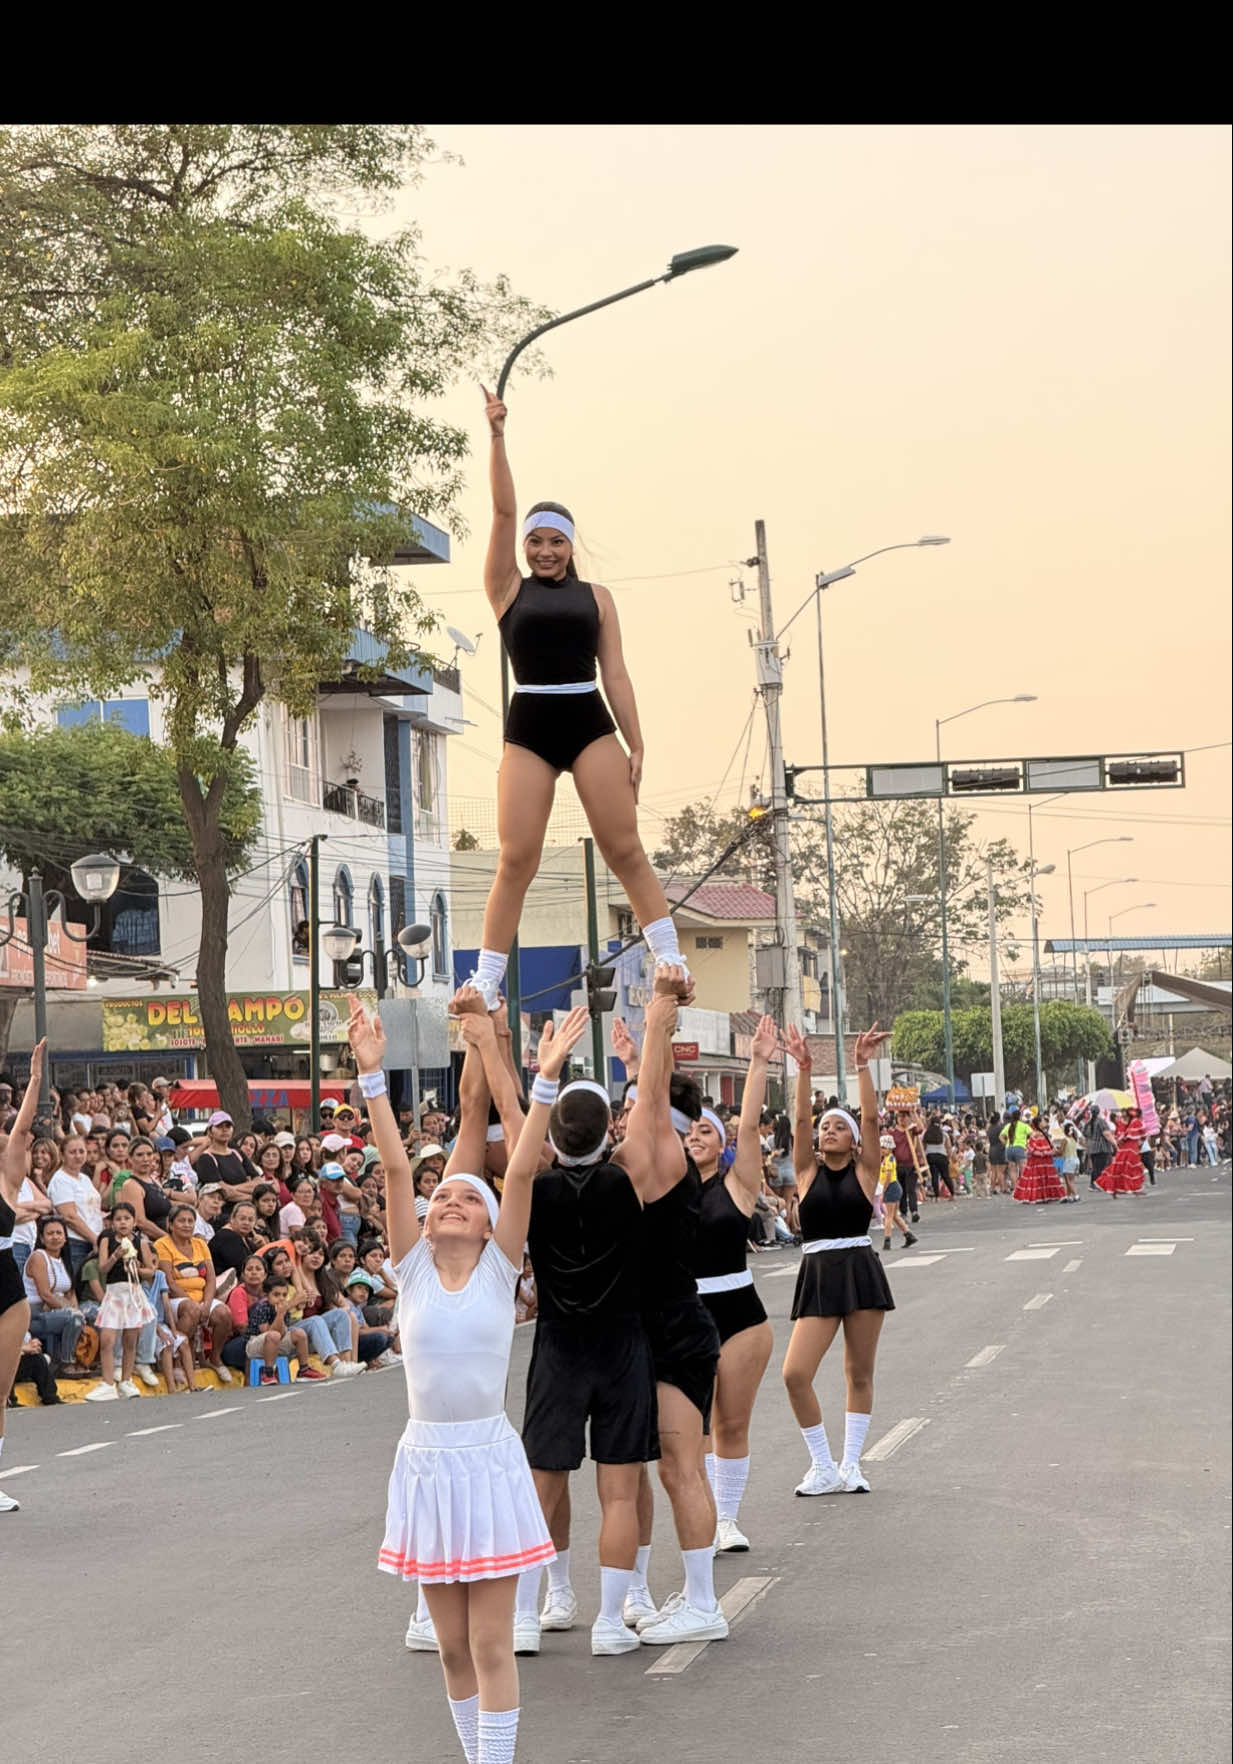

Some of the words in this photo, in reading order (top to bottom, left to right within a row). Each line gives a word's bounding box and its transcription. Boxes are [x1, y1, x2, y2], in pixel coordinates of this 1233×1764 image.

[147, 1000, 198, 1026] DEL
[228, 996, 305, 1023] AMPO
[251, 1090, 289, 1108] ZZA
